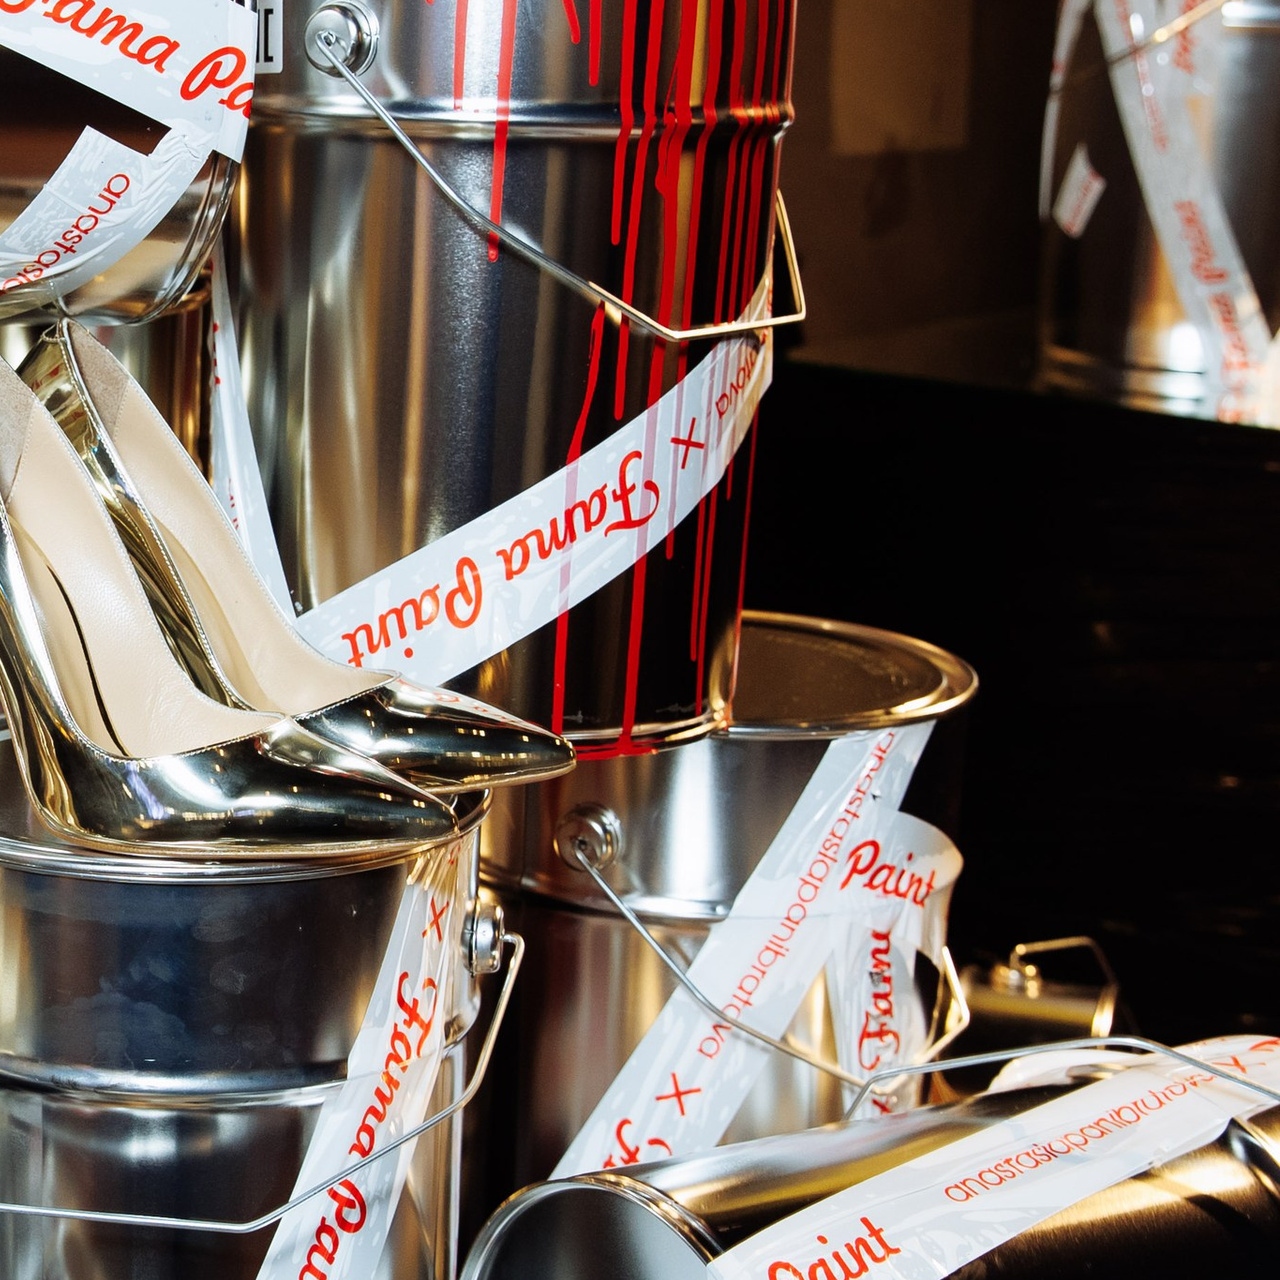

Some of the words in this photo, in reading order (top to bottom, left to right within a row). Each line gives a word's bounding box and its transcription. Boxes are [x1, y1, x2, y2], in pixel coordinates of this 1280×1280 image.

[501, 449, 662, 582] Fama
[342, 556, 485, 669] Paint
[697, 732, 896, 1060] anastasiapanibratova
[840, 839, 936, 908] Paint
[348, 970, 438, 1160] Fama
